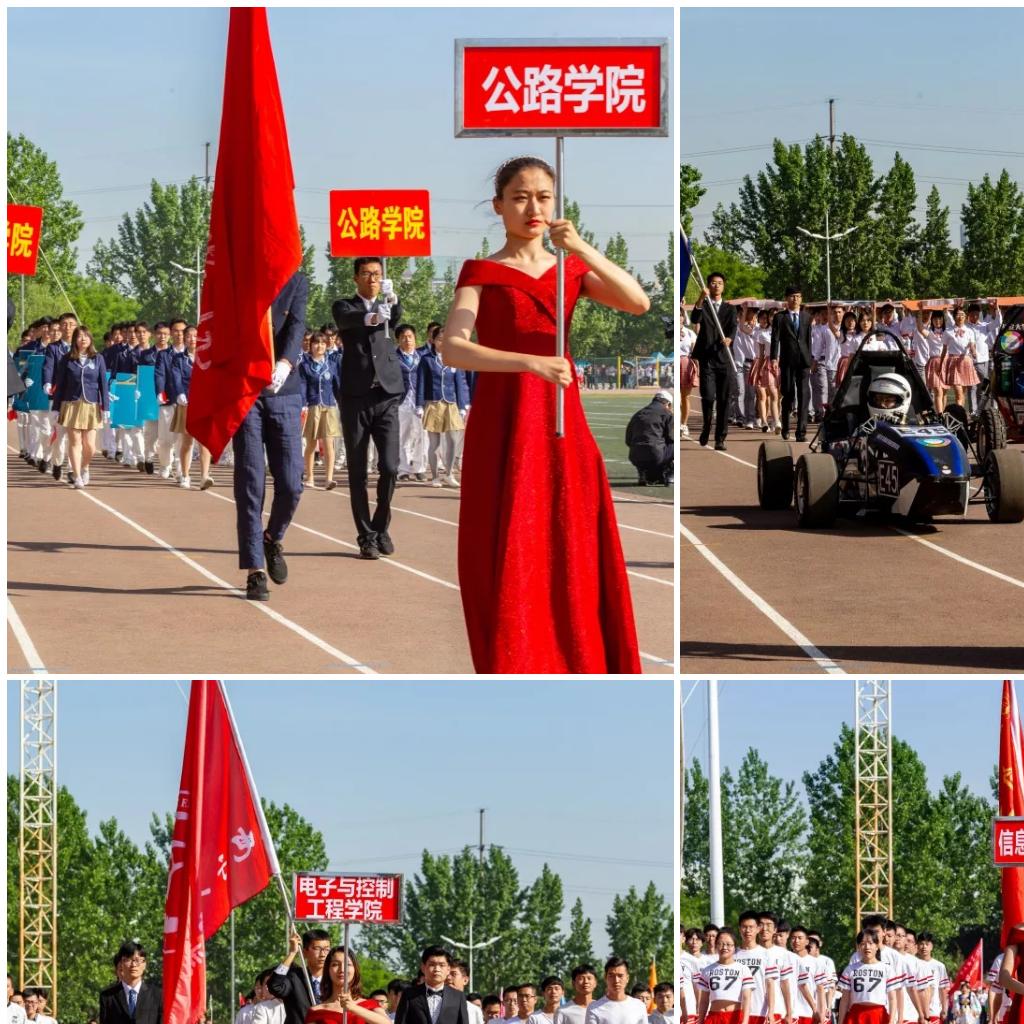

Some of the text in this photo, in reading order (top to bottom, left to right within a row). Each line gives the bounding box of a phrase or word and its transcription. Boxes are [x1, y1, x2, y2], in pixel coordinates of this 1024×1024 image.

[482, 63, 647, 114] 公路学院
[337, 205, 426, 241] 公路学院
[7, 220, 34, 257] 院
[879, 462, 898, 493] E45
[299, 877, 394, 898] 电子与控制
[305, 899, 383, 920] 工程学院
[709, 976, 738, 991] 67
[853, 969, 883, 977] BOSTON
[853, 977, 882, 992] 67
